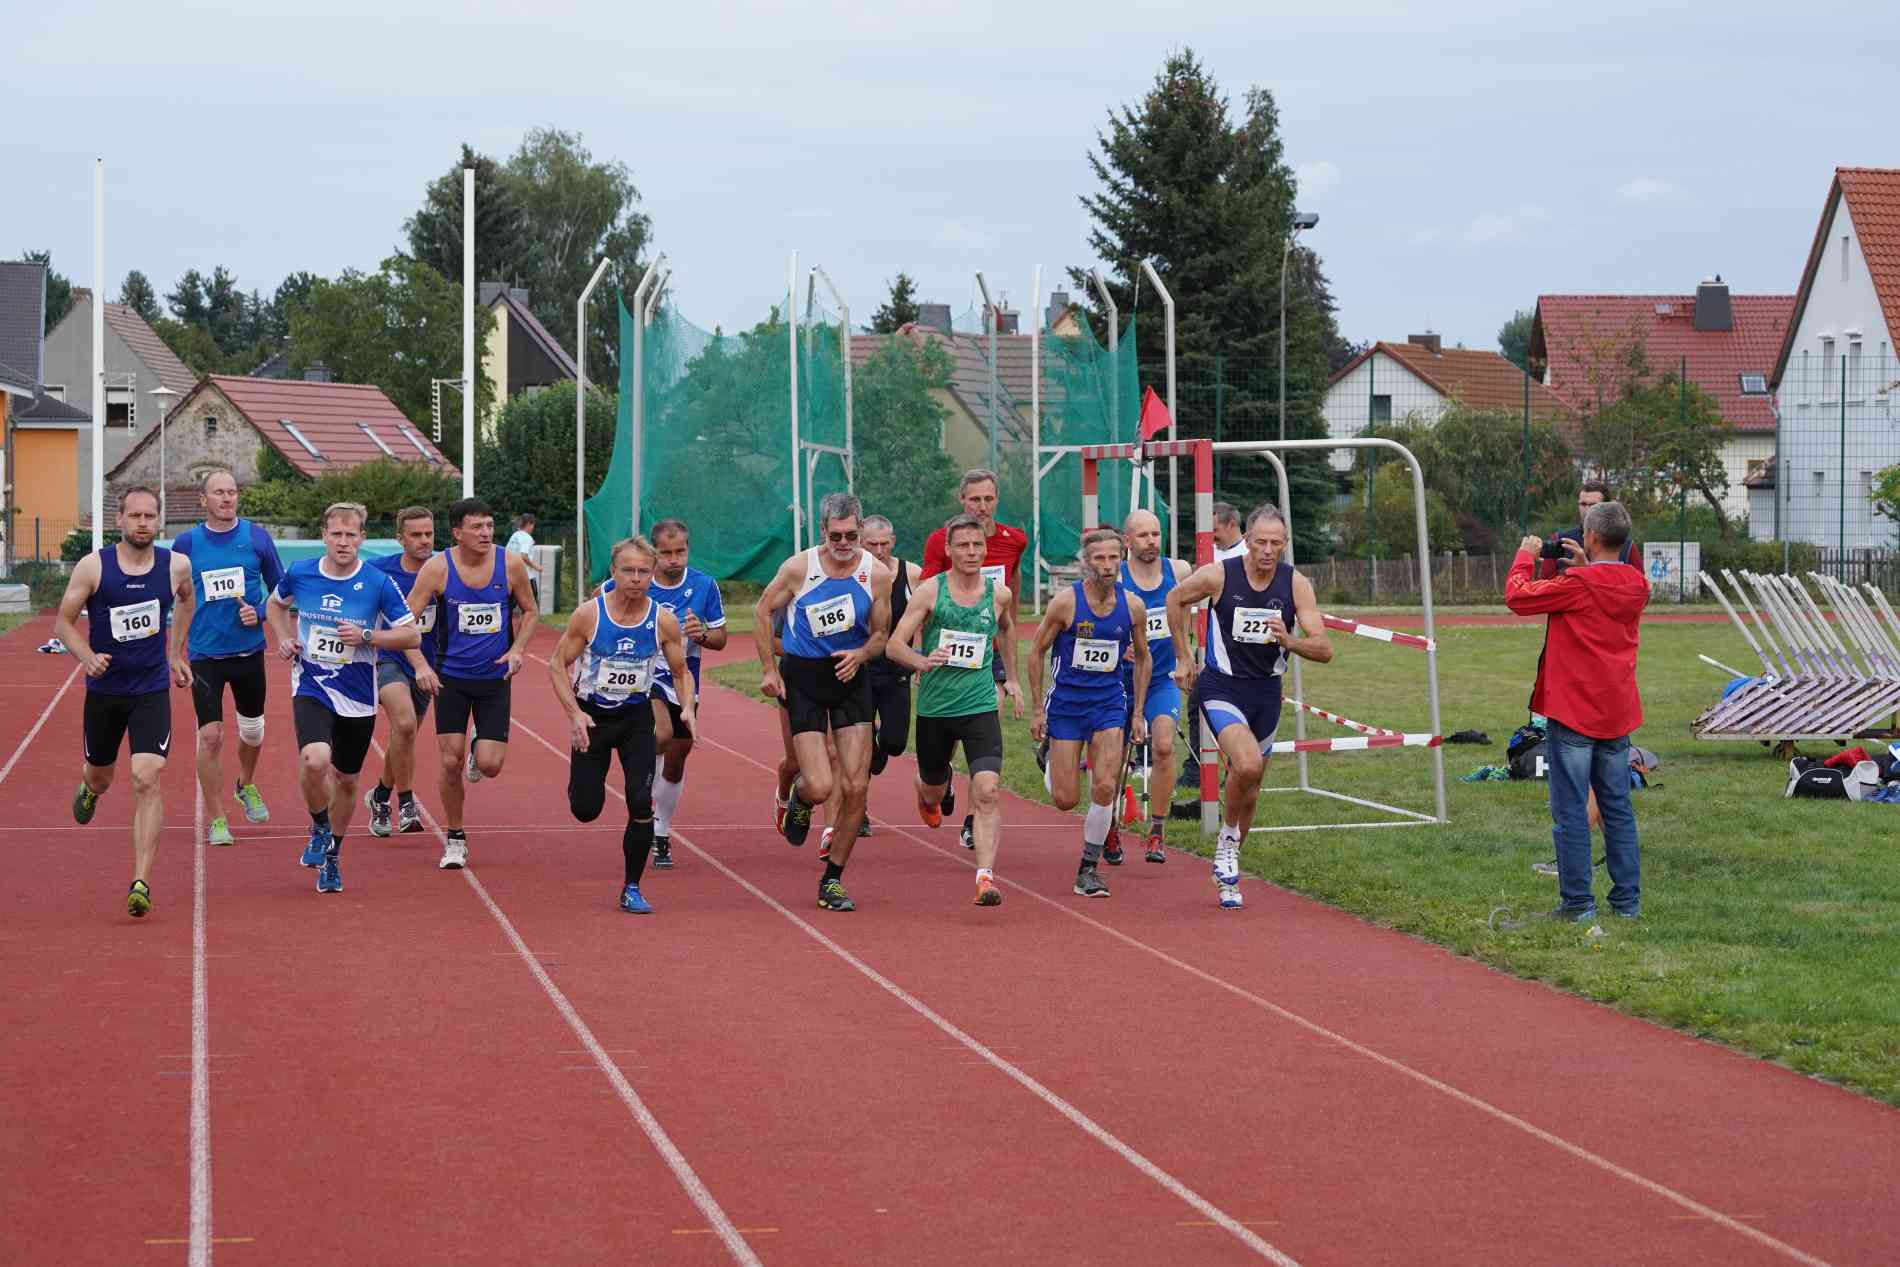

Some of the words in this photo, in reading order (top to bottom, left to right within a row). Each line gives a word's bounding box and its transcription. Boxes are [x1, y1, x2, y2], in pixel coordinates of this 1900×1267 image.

[213, 579, 235, 591] 110
[122, 615, 151, 631] 160
[467, 614, 493, 626] 209
[818, 609, 846, 627] 186
[1147, 619, 1162, 632] 12
[1242, 620, 1269, 634] 227
[318, 638, 345, 654] 210
[950, 644, 976, 658] 115
[1084, 649, 1110, 663] 120
[608, 672, 637, 685] 208
